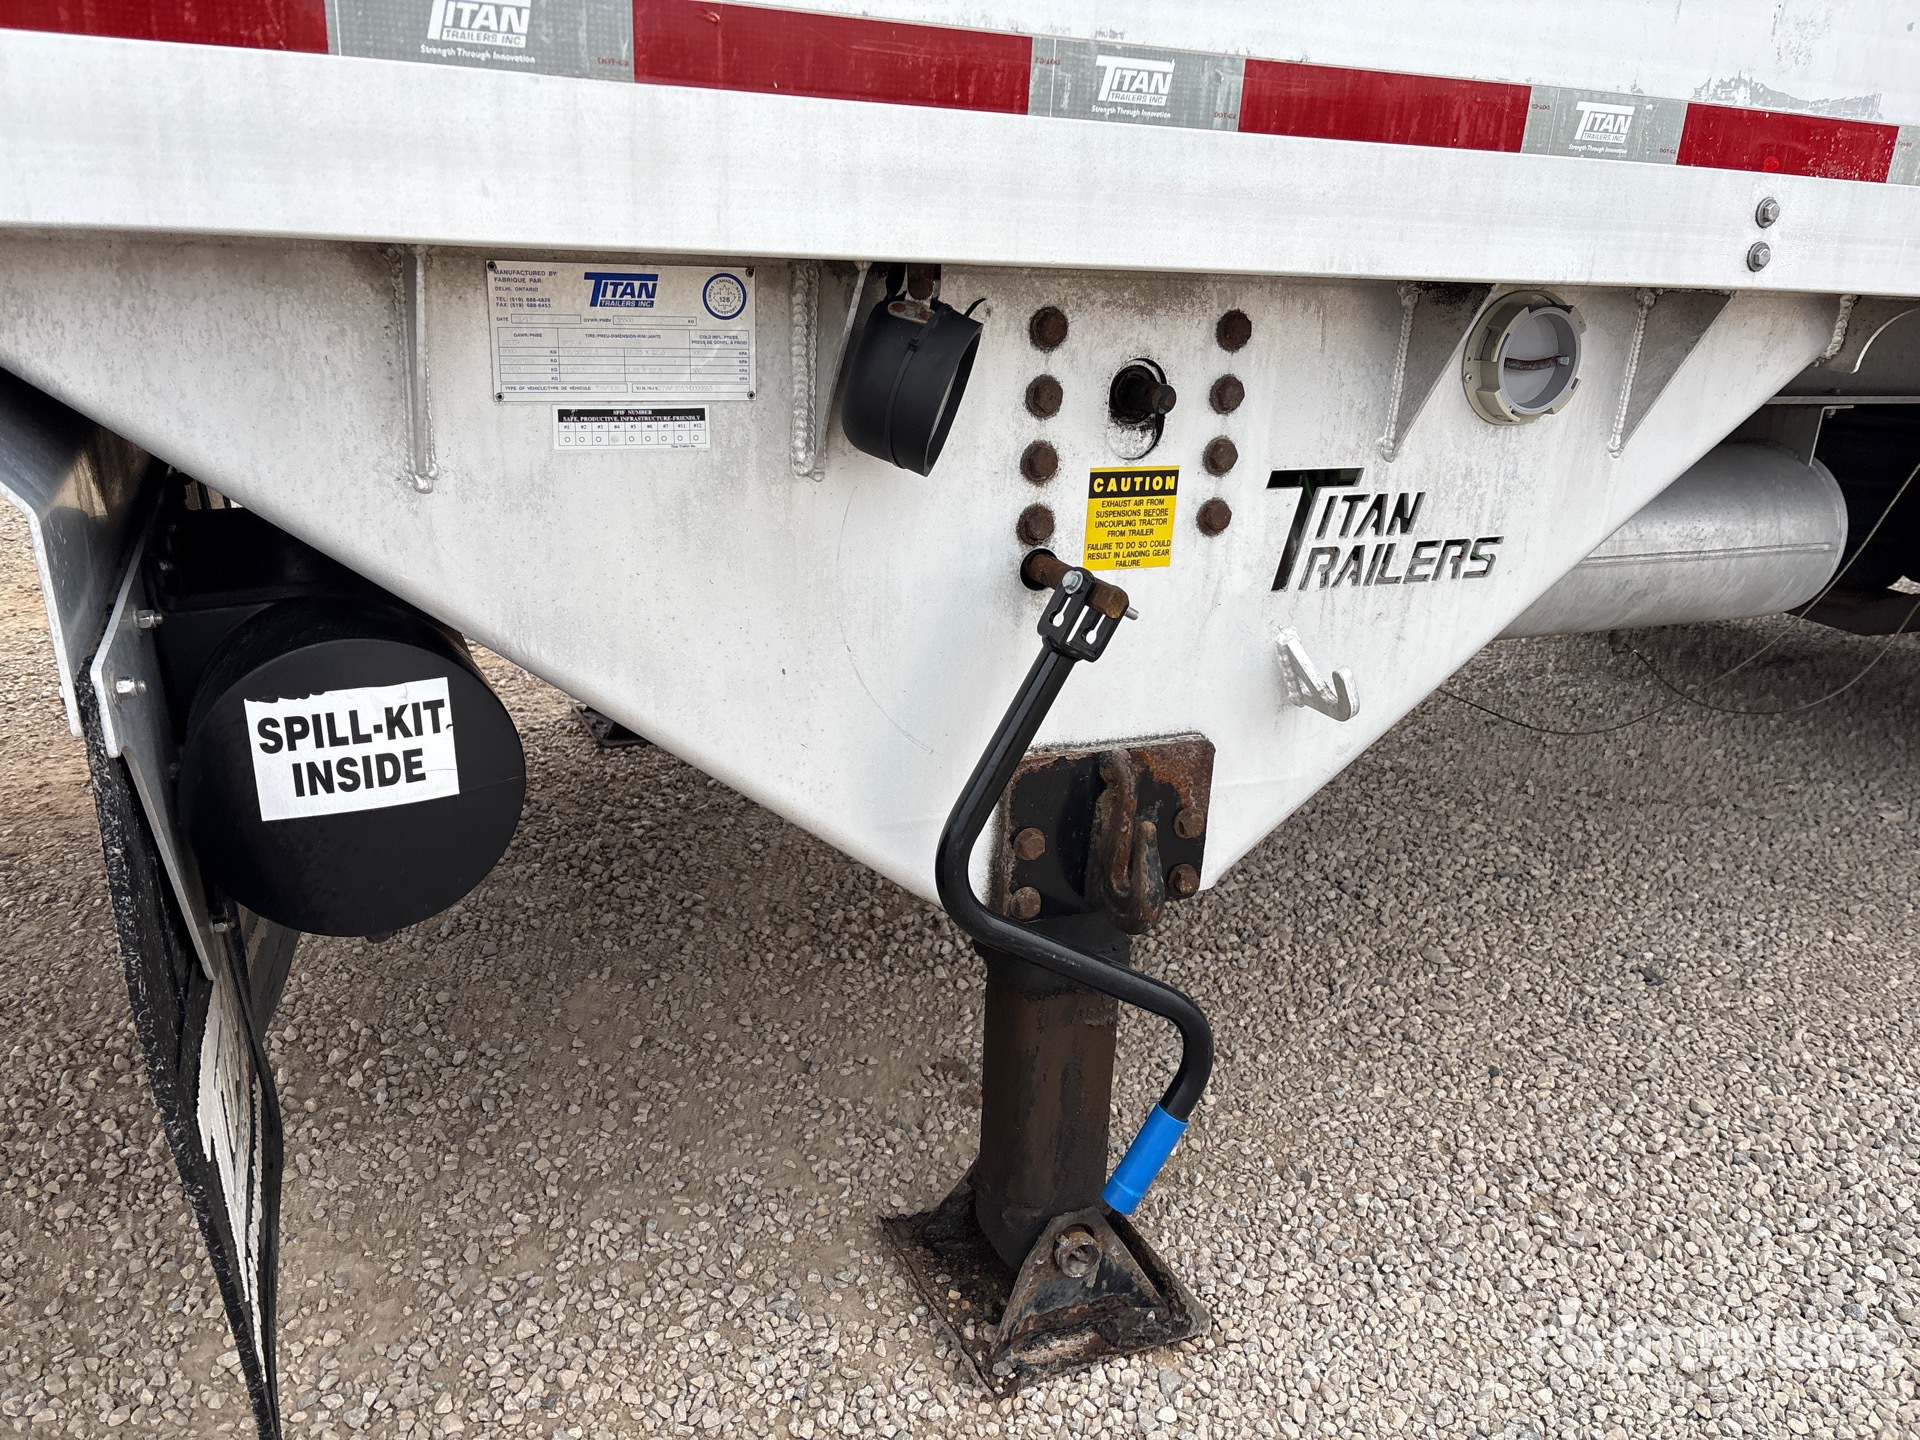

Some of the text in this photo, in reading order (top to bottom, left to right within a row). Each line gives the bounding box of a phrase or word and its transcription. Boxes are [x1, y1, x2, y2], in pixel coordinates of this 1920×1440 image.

[427, 0, 532, 40] TITAN
[445, 30, 523, 46] TRAILERS INC.
[420, 44, 536, 64] Strength Through Innovation
[1096, 55, 1175, 101] TITAN
[1111, 92, 1147, 103] TRAILERS
[1092, 104, 1171, 119] Strength Through Innovation
[1574, 101, 1636, 140] TITAN
[1584, 132, 1612, 141] TRAILERS
[1568, 143, 1586, 152] Strength
[1587, 145, 1605, 154] Through
[584, 272, 659, 307] TITAN
[638, 300, 653, 308] INC.
[713, 305, 738, 315] TRANSPORT
[1093, 475, 1176, 493] CAUTION
[1101, 498, 1165, 508] EXHAUST AIR FROM
[1095, 508, 1169, 518] SUSPENSIONS BEFORE
[1095, 518, 1168, 528] UNCOUPLING TRACTOR
[1107, 528, 1154, 537] FROM TRAILER
[1266, 467, 1427, 592] TITAN
[1087, 539, 1171, 551] FAILURE TO DO SO COULD
[1087, 549, 1170, 560] RESULT IN LANDING GEAR
[1115, 559, 1141, 567] FAILURE
[257, 698, 446, 755] SPILL-KIT
[292, 748, 427, 798] INSIDE
